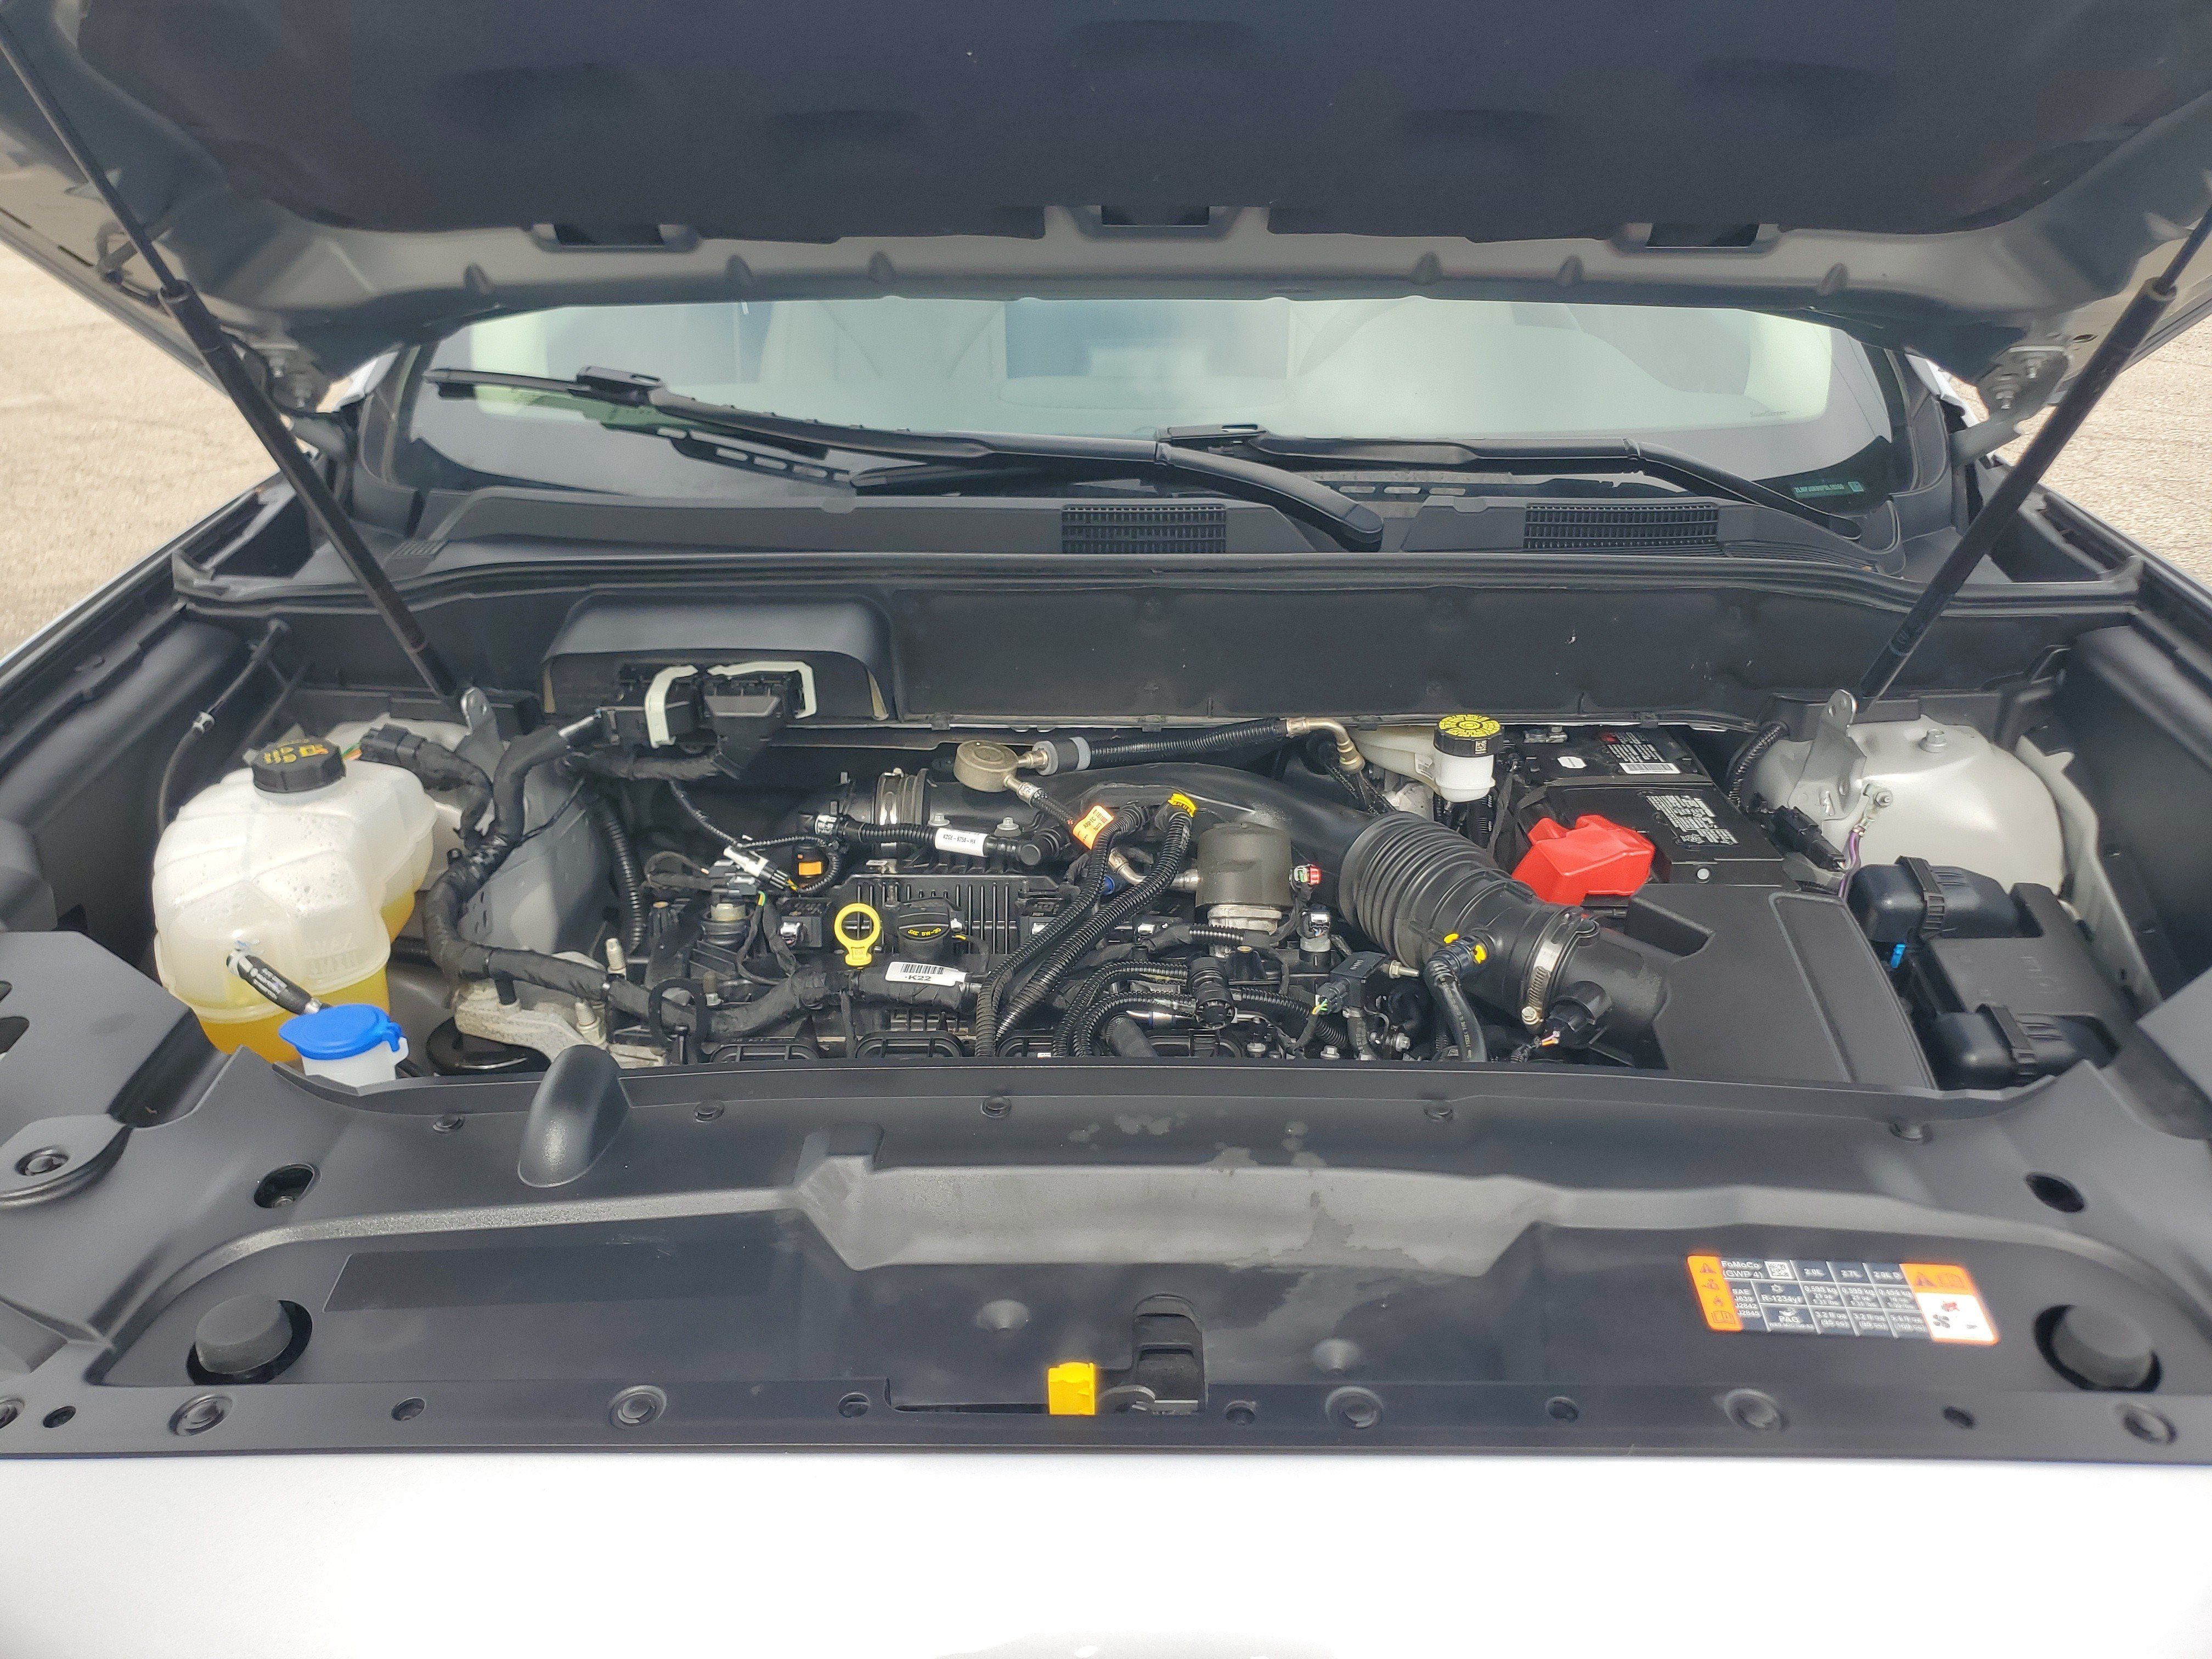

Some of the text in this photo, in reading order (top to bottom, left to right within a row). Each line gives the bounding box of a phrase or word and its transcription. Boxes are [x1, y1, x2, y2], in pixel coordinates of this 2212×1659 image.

[1753, 1271, 1763, 1279] 4)
[1826, 1287, 1838, 1295] kg
[1761, 1294, 1802, 1304] R-1234yf
